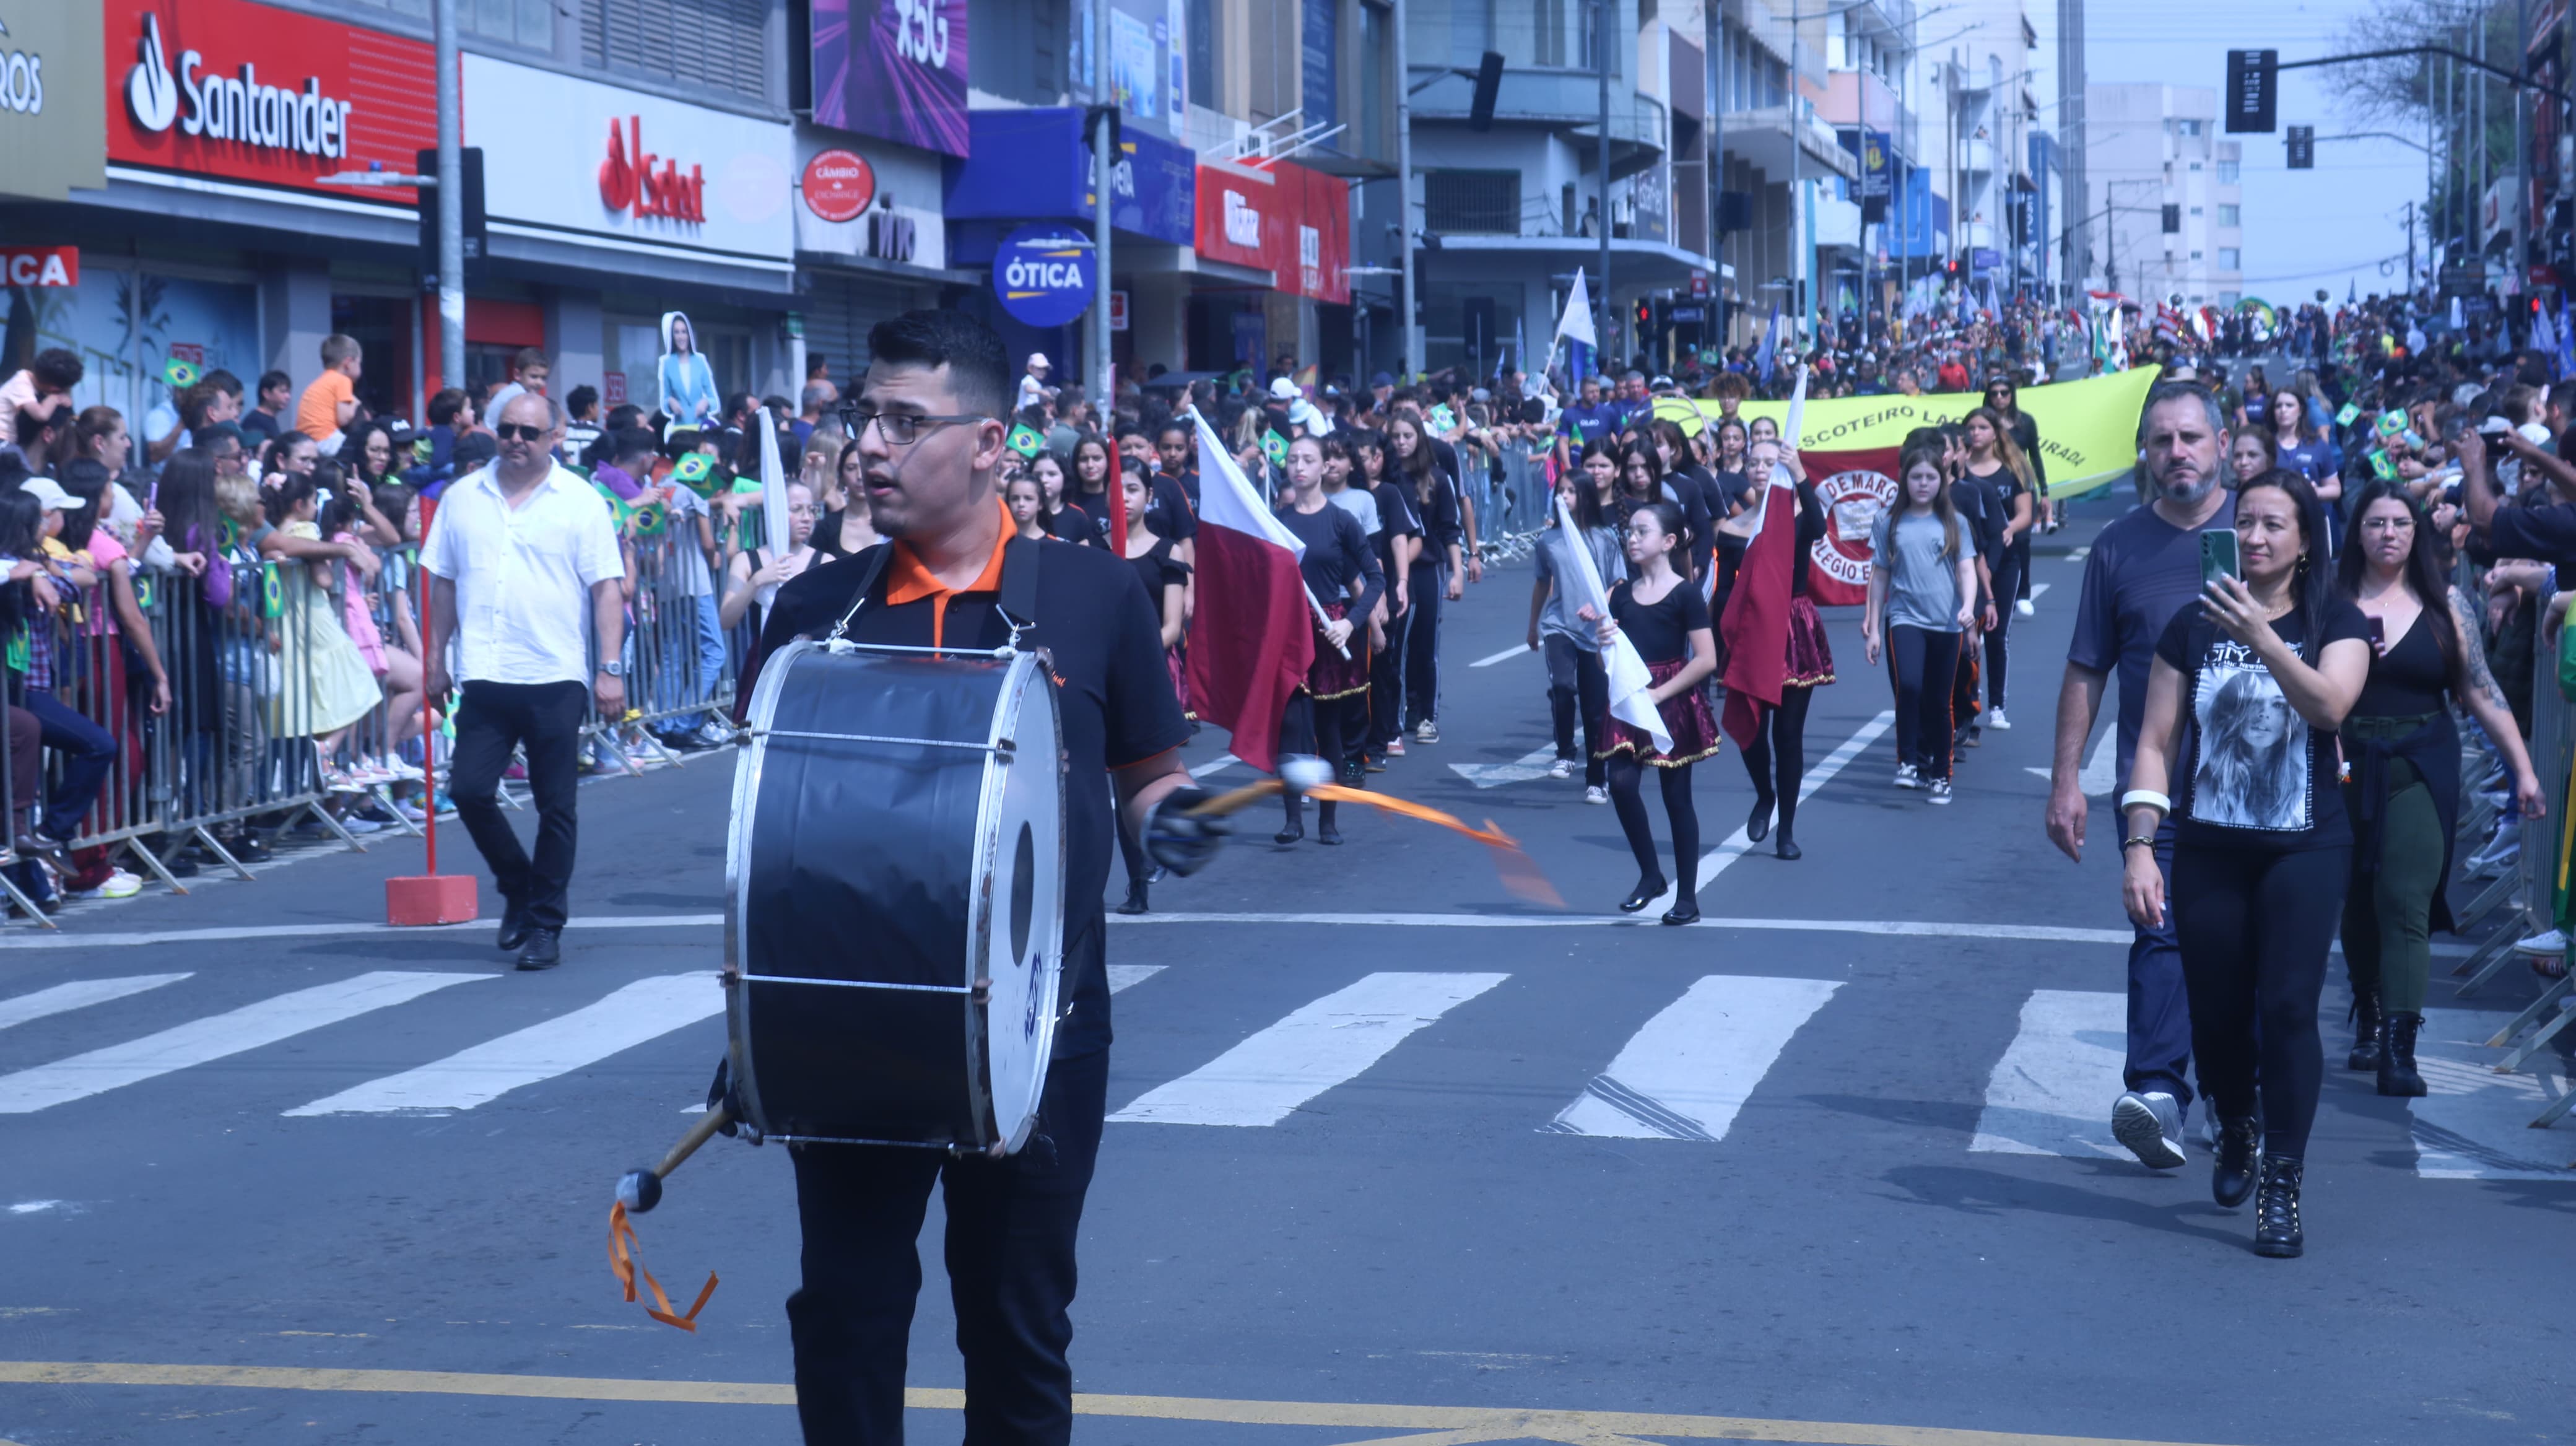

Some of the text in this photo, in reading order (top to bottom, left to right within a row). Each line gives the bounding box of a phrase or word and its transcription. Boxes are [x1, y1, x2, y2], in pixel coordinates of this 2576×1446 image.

[181, 50, 352, 159] Santander
[815, 165, 860, 179] CÂMBIO
[1005, 255, 1084, 289] ÓTICA
[1796, 406, 1915, 452] SCOTEIRO
[1997, 485, 2012, 499] 31
[2239, 662, 2268, 671] NEWSPA
